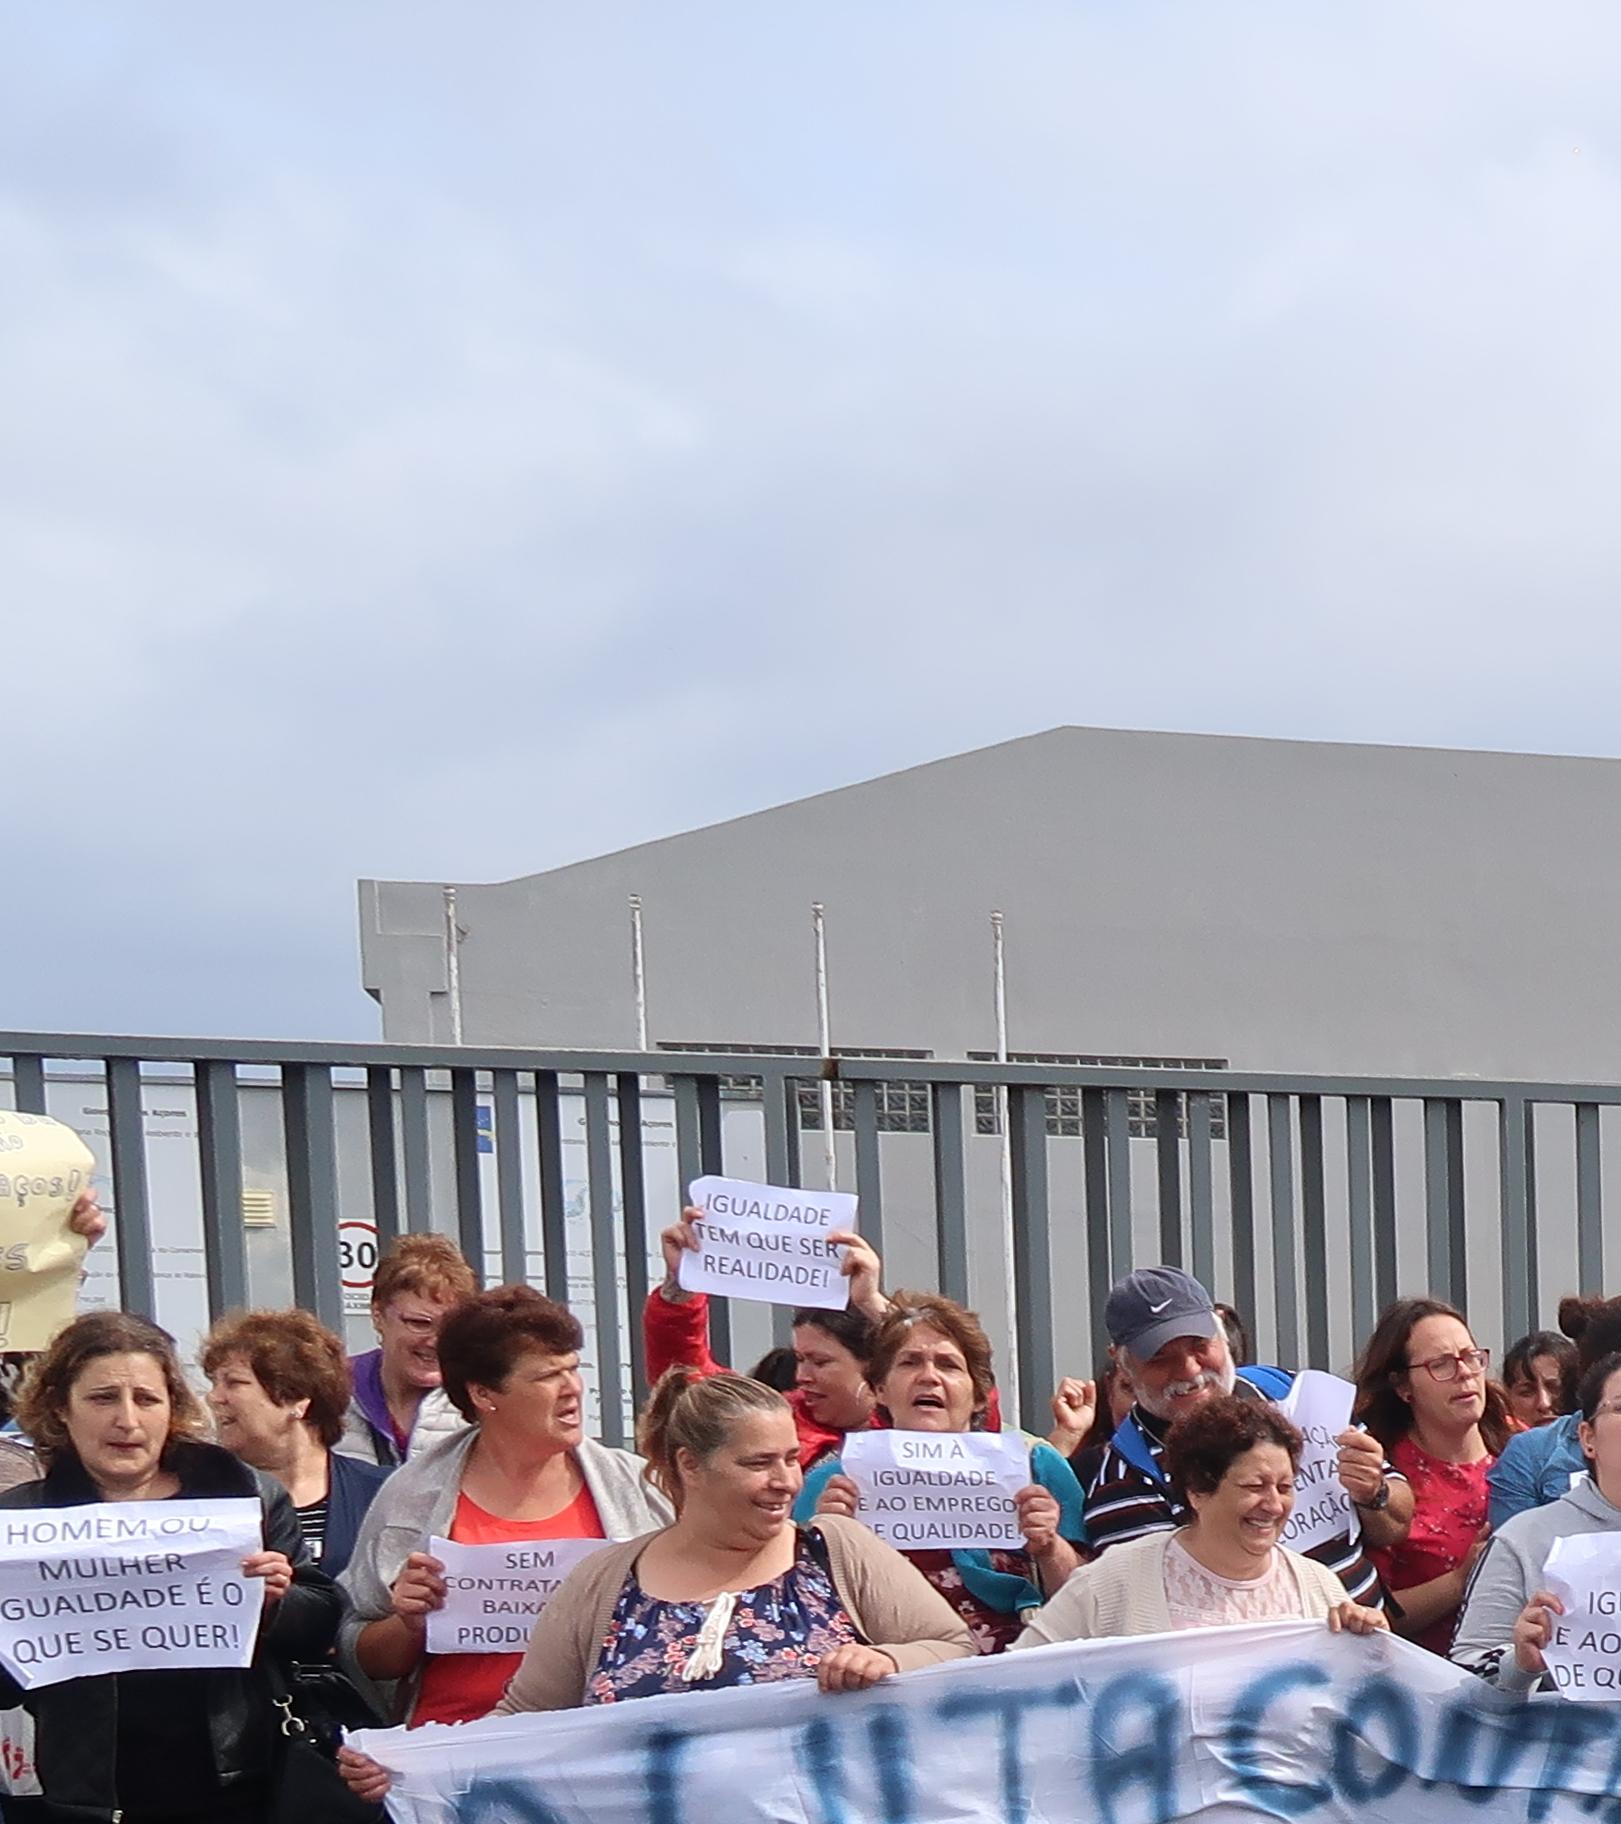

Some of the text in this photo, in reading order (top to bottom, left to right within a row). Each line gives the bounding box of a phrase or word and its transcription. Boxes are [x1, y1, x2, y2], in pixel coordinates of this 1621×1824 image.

[706, 1193, 831, 1227] IGUALDADE
[696, 1222, 840, 1259] TEM QUE SER
[339, 1241, 377, 1268] 30
[704, 1254, 830, 1288] REALIDADE!
[902, 1439, 965, 1459] SIM À
[873, 1470, 996, 1487] IGUALDADE
[859, 1496, 1018, 1513] E AO EMPREGO
[7, 1518, 210, 1545] HOMEM OU
[866, 1523, 885, 1540] E
[38, 1553, 187, 1581] MULHER
[506, 1551, 555, 1569] SEM
[443, 1576, 564, 1593] CONTRATA
[1, 1576, 243, 1621] GUALDADE É O
[13, 1624, 240, 1664] QUE SE QUER!
[1555, 1626, 1571, 1646] E
[1578, 1632, 1621, 1655] AO
[1554, 1664, 1585, 1687] DE
